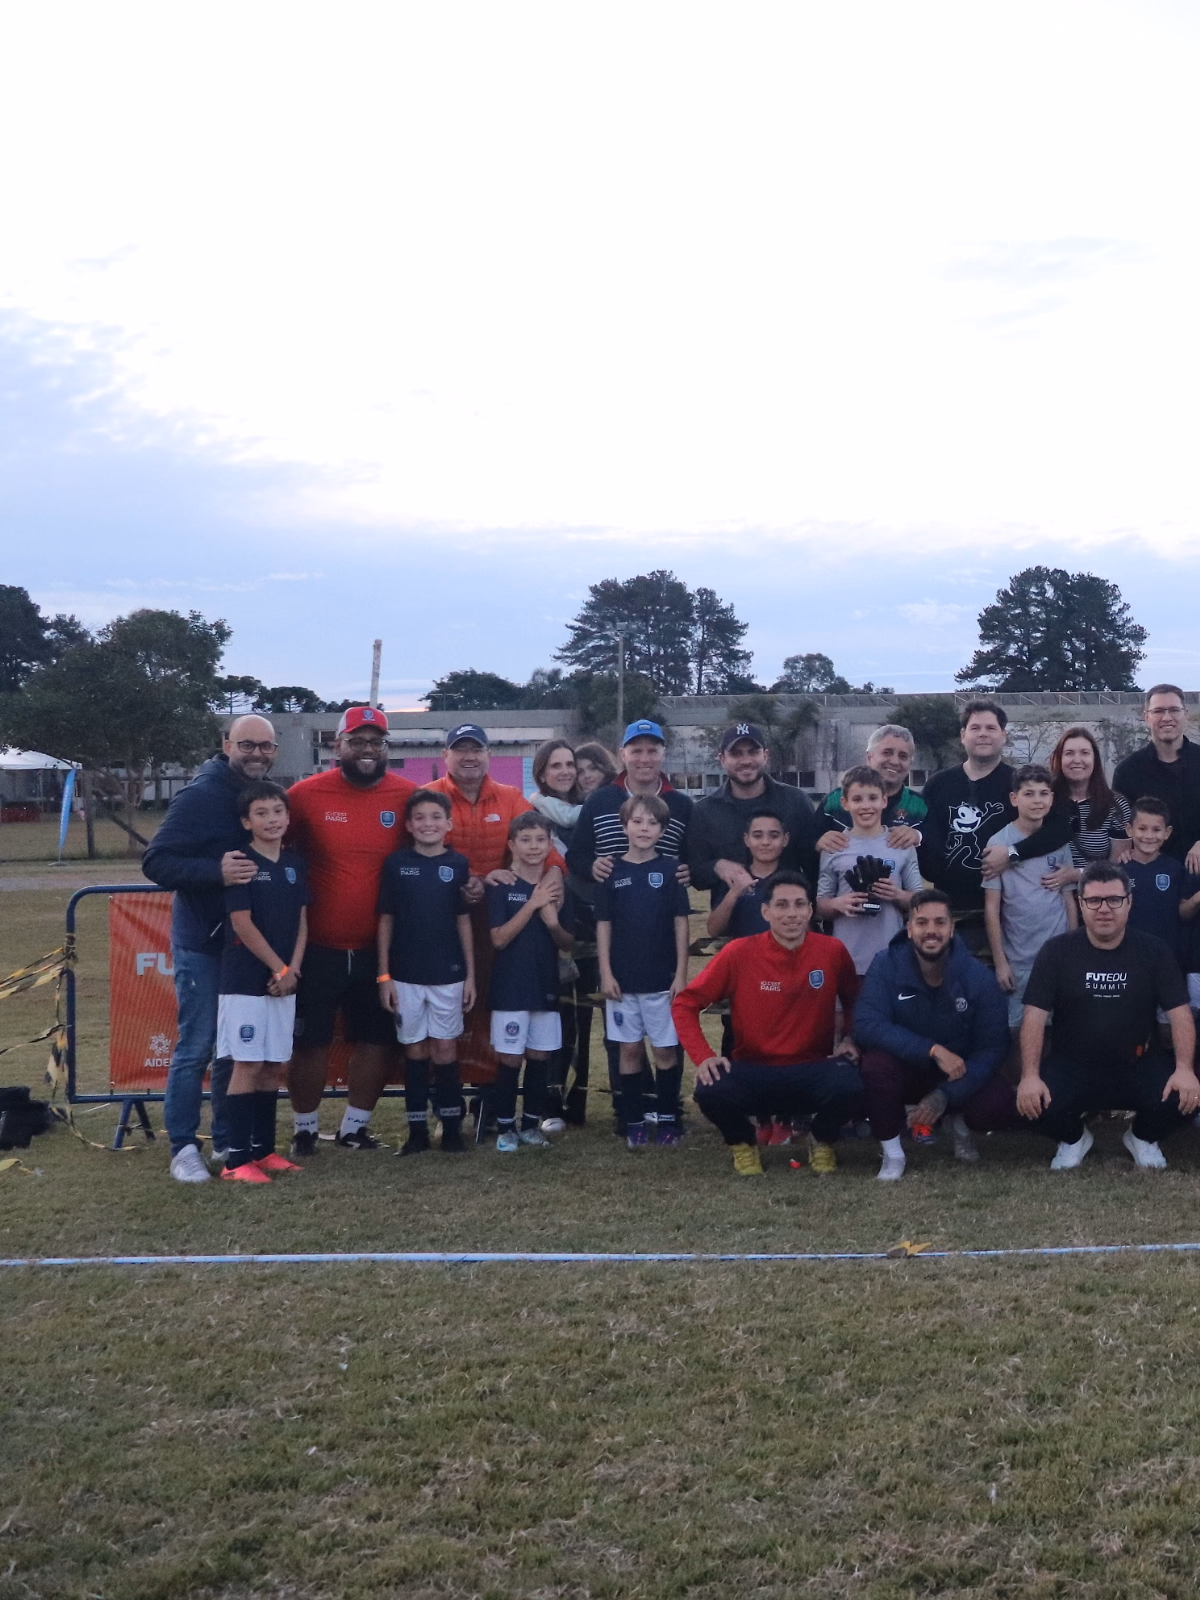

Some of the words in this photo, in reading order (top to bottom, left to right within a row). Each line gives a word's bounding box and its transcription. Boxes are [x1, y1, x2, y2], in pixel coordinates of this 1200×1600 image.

[736, 723, 750, 735] NY
[325, 815, 348, 823] PARIS
[1085, 972, 1127, 982] FUTEDU
[1085, 982, 1128, 990] SUMMIT
[144, 1058, 172, 1068] AIDE
